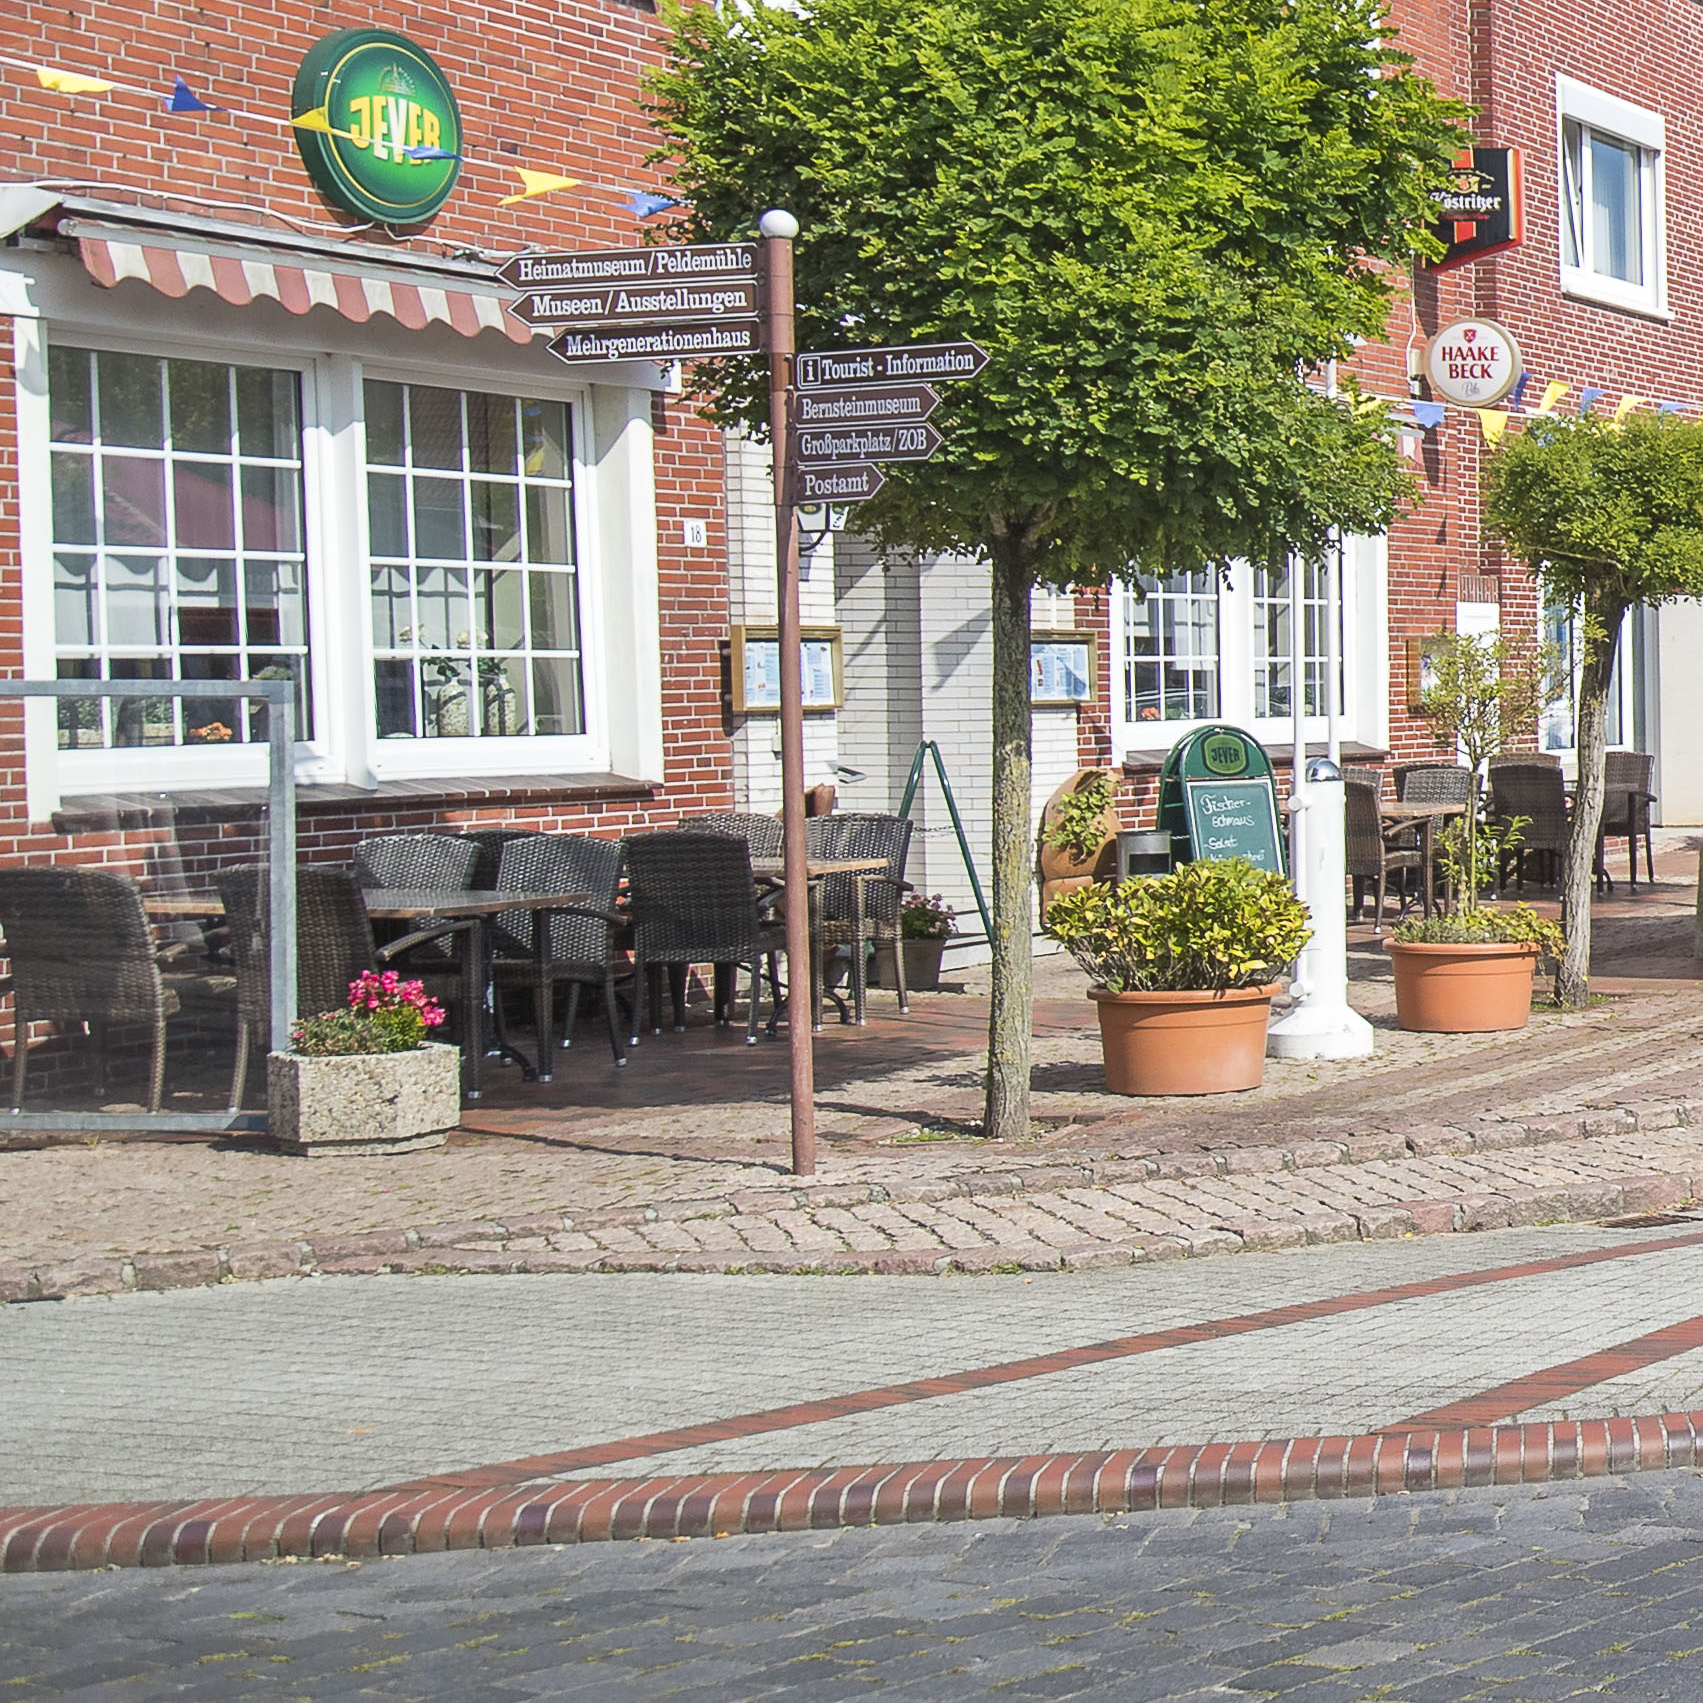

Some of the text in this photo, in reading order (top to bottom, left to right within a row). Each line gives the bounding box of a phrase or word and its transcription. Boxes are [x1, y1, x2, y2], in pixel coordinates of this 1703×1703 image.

[350, 95, 440, 166] JEVER
[532, 295, 603, 317] Museen
[615, 288, 748, 313] Ausstellungen
[566, 327, 751, 359] Mehrgenerationenhaus
[1441, 346, 1500, 362] HAAKE
[822, 357, 875, 380] Tourist
[885, 350, 975, 375] Information
[1449, 363, 1494, 379] BECK
[802, 396, 921, 419] Bernsteinmuseum
[804, 472, 870, 496] Postamt
[689, 524, 703, 544] 18
[1211, 746, 1240, 765] JEVER
